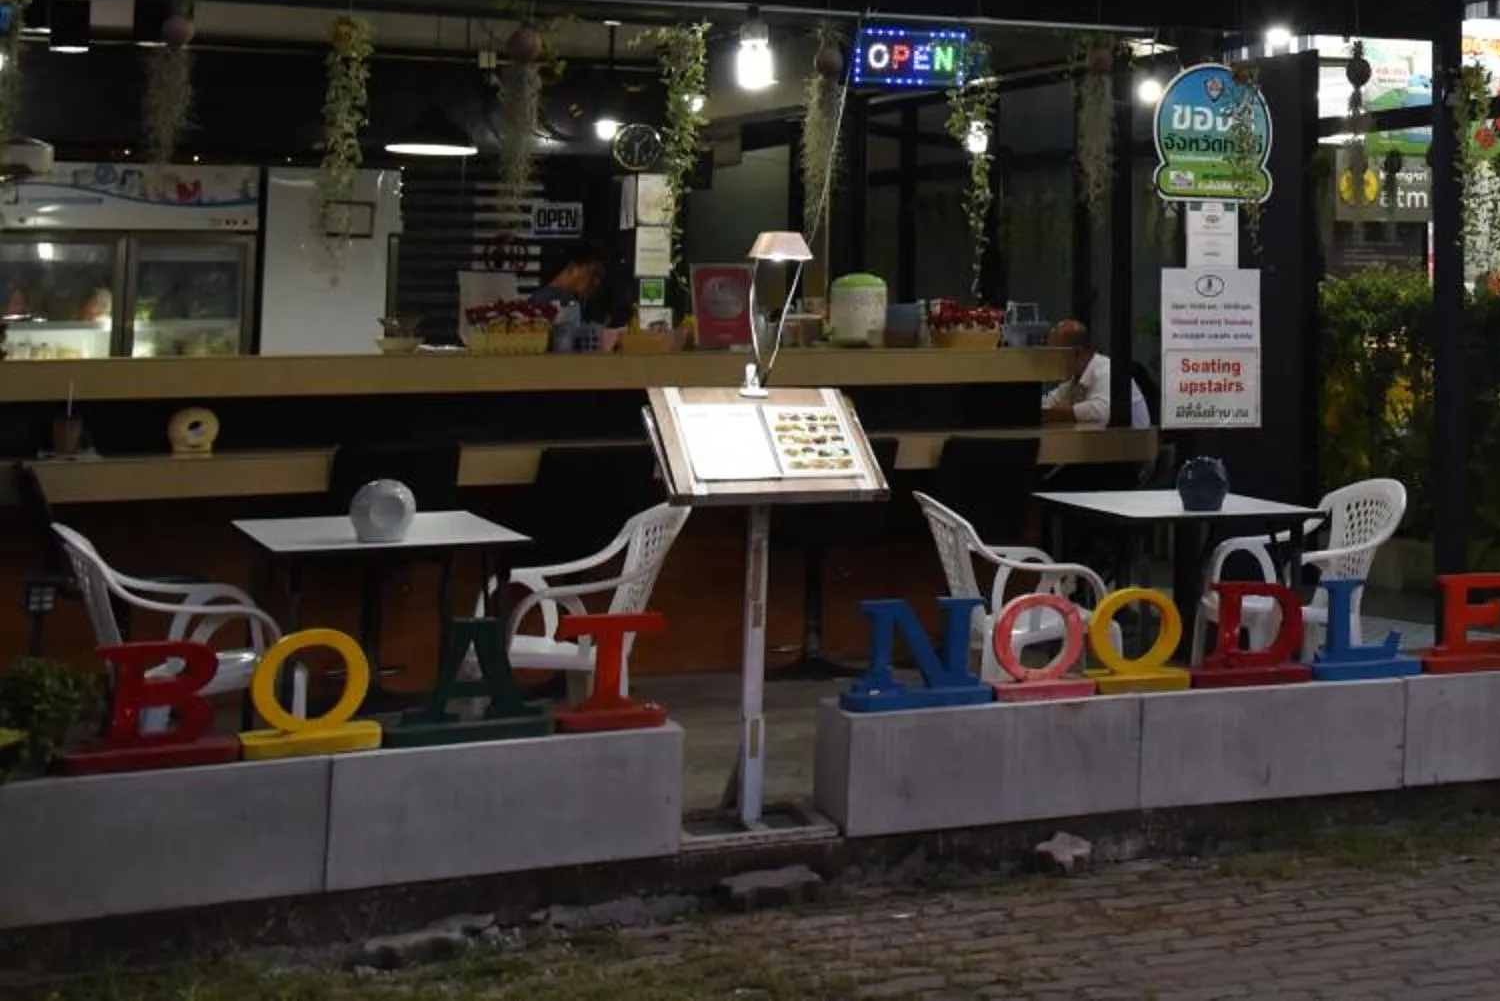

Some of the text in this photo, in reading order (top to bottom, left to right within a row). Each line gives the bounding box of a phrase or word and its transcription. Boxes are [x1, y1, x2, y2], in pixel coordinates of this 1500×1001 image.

[868, 43, 953, 71] OPEN
[536, 208, 578, 230] OPEN
[1181, 358, 1241, 376] Seating
[1179, 379, 1244, 396] upstairs
[94, 611, 664, 749] BOAT
